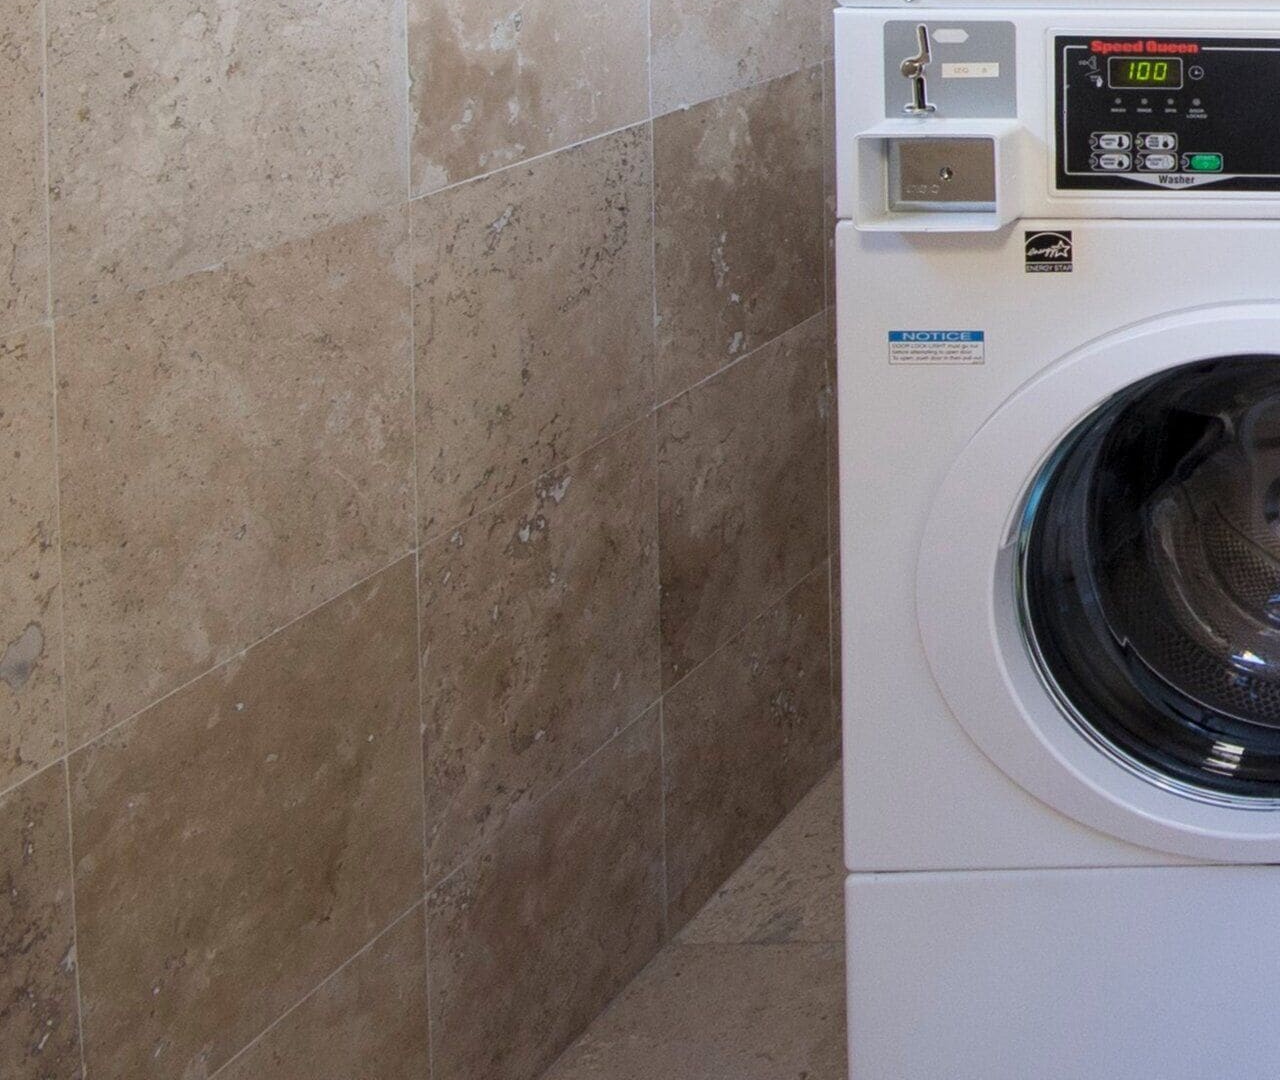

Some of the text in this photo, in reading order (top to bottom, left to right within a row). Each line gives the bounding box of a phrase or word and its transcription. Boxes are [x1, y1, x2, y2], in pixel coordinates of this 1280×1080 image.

[1090, 40, 1199, 54] Speed Queen
[1129, 62, 1168, 81] 100
[1159, 175, 1195, 185] Washer
[1026, 264, 1073, 272] ENERGY STAR
[902, 331, 972, 341] NOTICE
